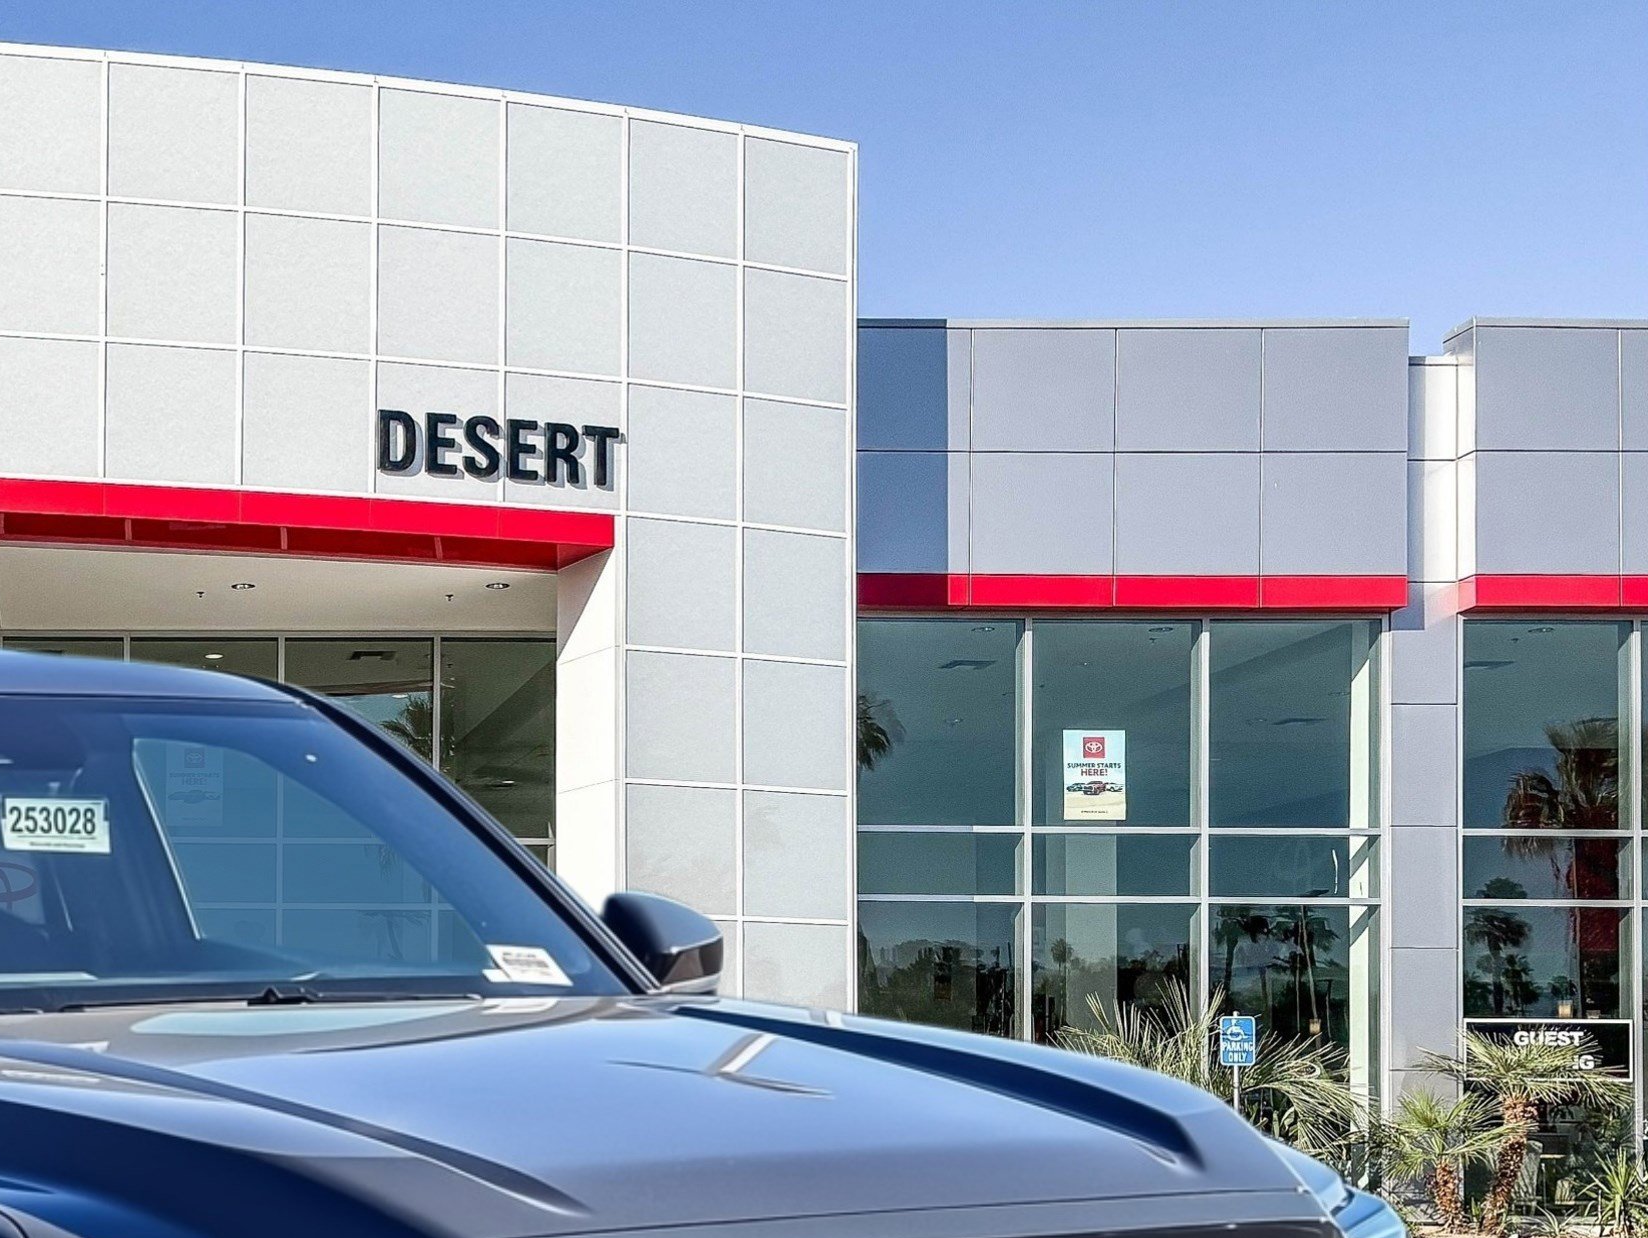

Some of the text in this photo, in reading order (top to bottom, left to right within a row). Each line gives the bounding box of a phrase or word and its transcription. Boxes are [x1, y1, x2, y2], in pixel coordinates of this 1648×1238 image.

[377, 409, 621, 486] DESERT
[1080, 768, 1108, 776] HERE!
[9, 806, 96, 835] 253028
[1513, 1031, 1584, 1047] GUEST
[1222, 1041, 1253, 1052] PARKING
[1228, 1052, 1248, 1062] ONLY
